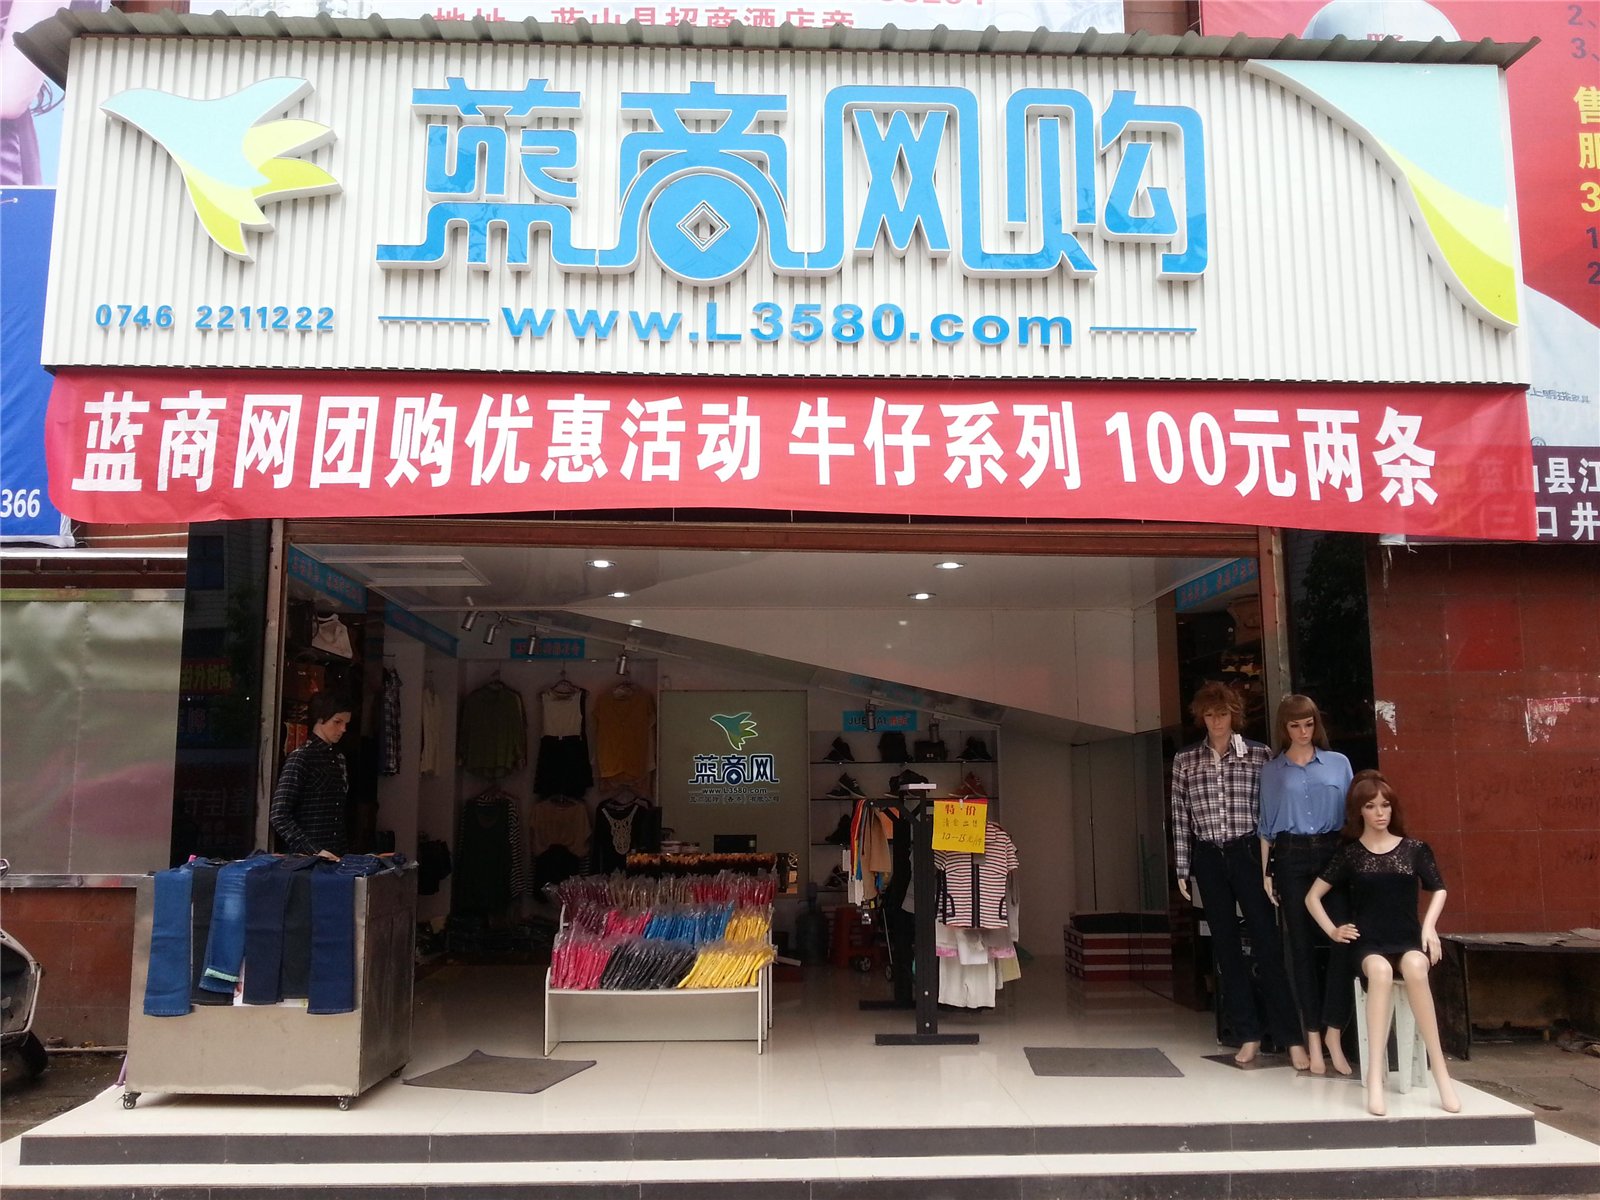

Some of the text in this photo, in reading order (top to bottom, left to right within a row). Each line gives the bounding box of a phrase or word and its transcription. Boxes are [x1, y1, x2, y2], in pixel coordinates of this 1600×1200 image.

[376, 77, 1207, 286] 蓝商网购
[95, 304, 335, 331] 0746 2211222
[501, 302, 1073, 347] www.L3580.com
[71, 390, 1439, 507] 蓝商网团购优惠活动 牛仔系列 100元两条
[1533, 457, 1600, 494] 县江
[0, 488, 40, 518] 366
[688, 753, 780, 786] 蓝商网
